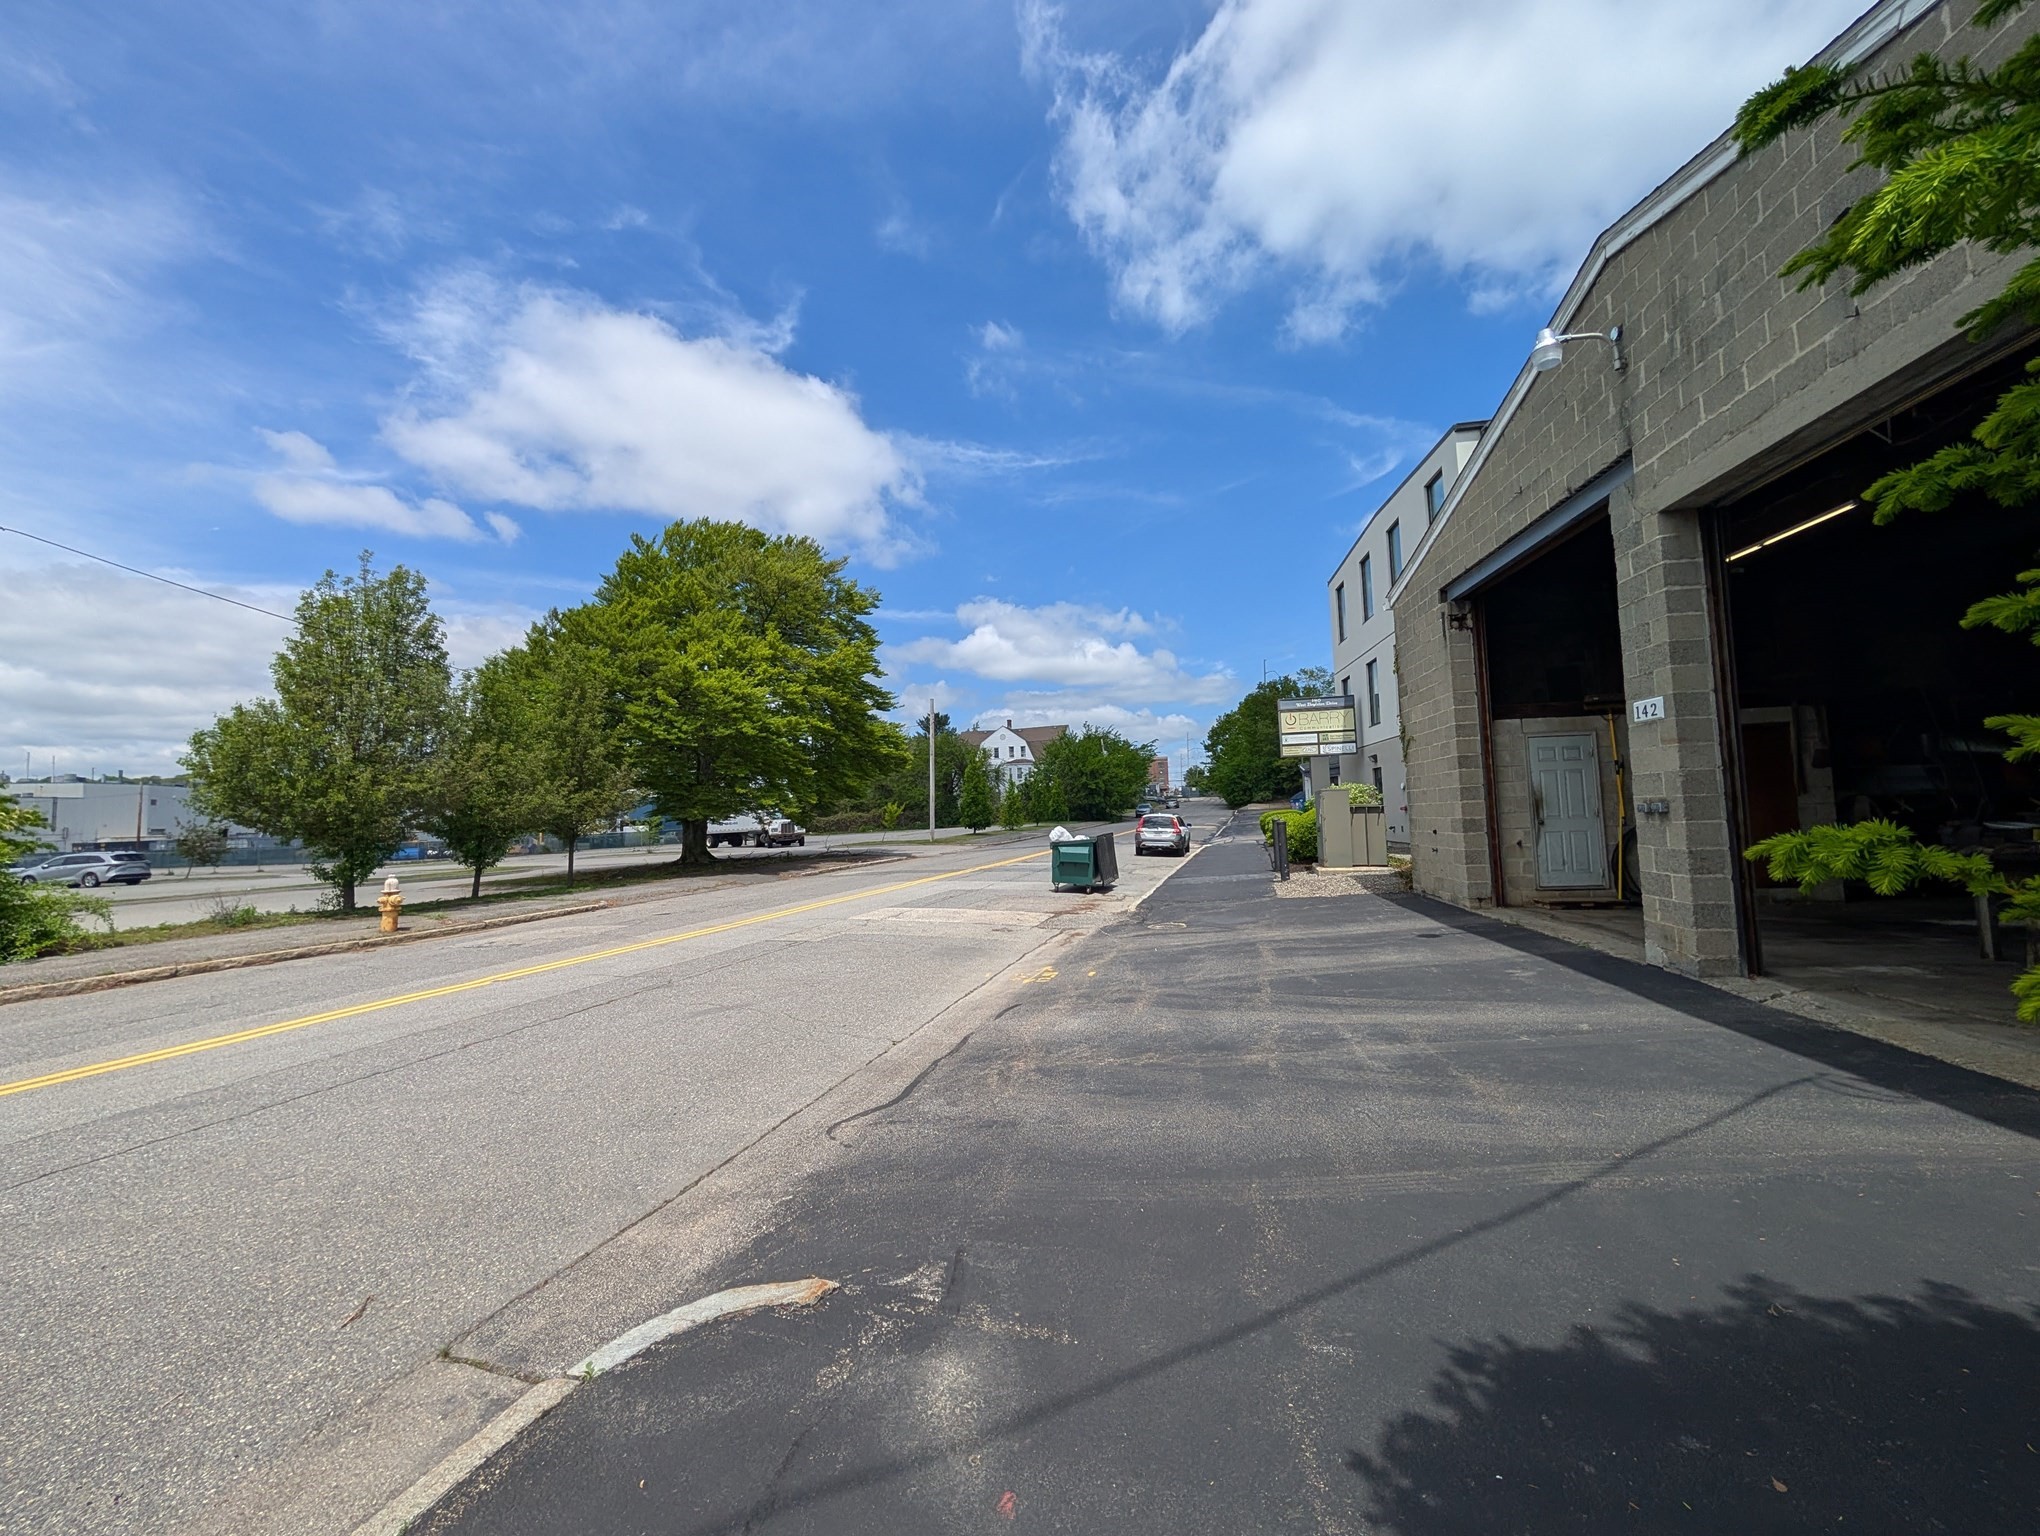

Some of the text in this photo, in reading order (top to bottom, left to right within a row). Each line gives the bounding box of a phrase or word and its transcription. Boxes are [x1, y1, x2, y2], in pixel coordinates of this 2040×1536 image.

[1298, 710, 1351, 726] BARRY
[1635, 703, 1658, 719] 142
[1327, 744, 1355, 752] SPINELLI
